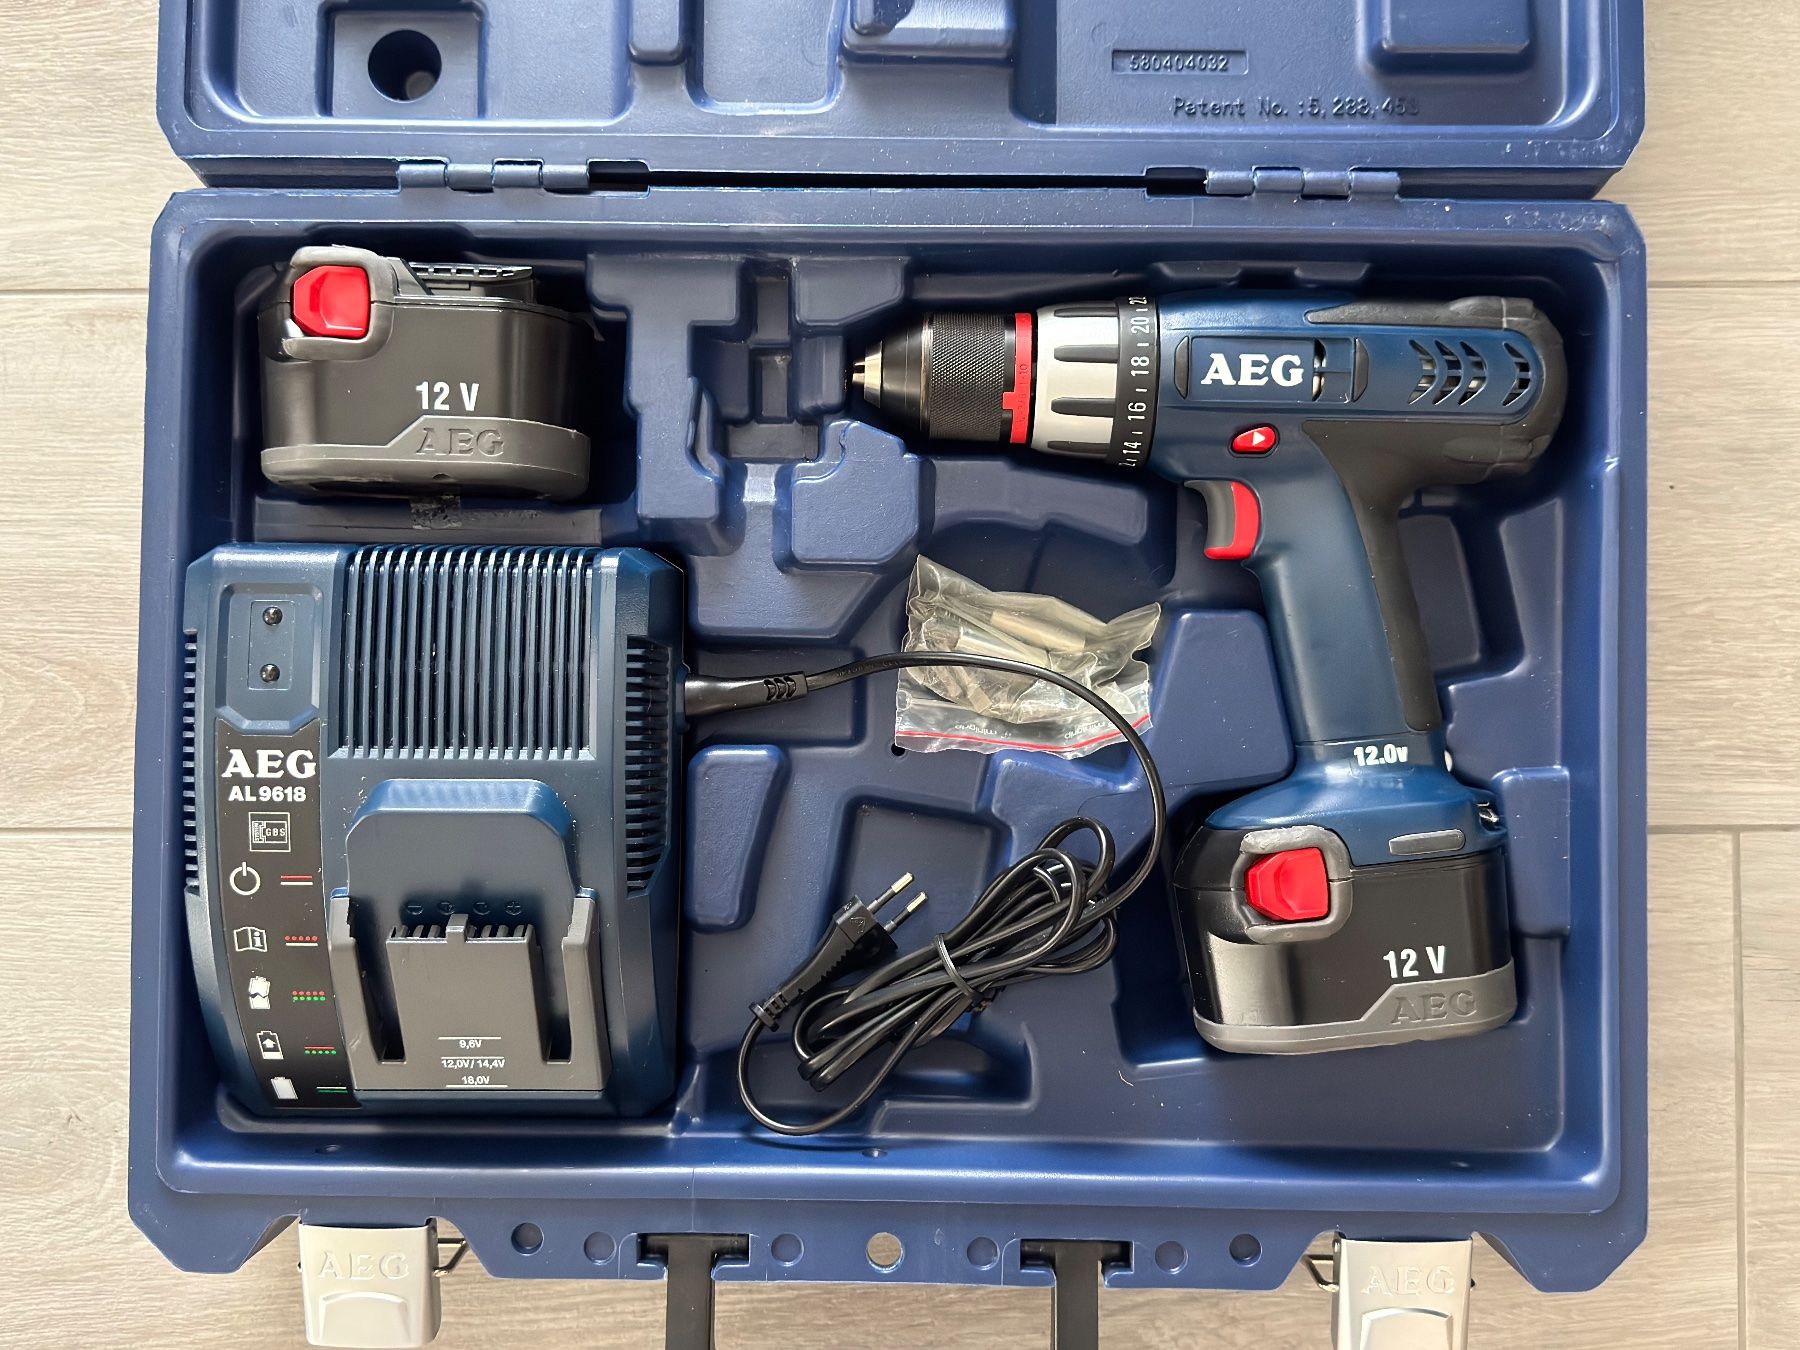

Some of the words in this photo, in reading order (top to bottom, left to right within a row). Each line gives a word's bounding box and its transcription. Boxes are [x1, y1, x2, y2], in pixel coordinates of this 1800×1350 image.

[1129, 53, 1229, 73] 580404032
[1173, 96, 1245, 116] Patent
[1258, 96, 1288, 116] No.
[1131, 316, 1150, 335] 20
[1130, 355, 1150, 377] 18
[1200, 352, 1304, 387] AEG
[415, 381, 450, 411] 12
[459, 382, 480, 411] V
[1127, 401, 1147, 421] 16
[415, 427, 505, 457] AEG
[1122, 441, 1142, 455] 14
[221, 748, 317, 779] AEG
[265, 827, 286, 837] GBS
[1383, 948, 1419, 979] 12
[1425, 945, 1446, 974] V
[1391, 989, 1477, 1024] AEG
[459, 1039, 482, 1049] 9,6V
[461, 1075, 490, 1085] 18,0V
[318, 1251, 411, 1281] AEG
[1361, 1264, 1455, 1297] AEG
